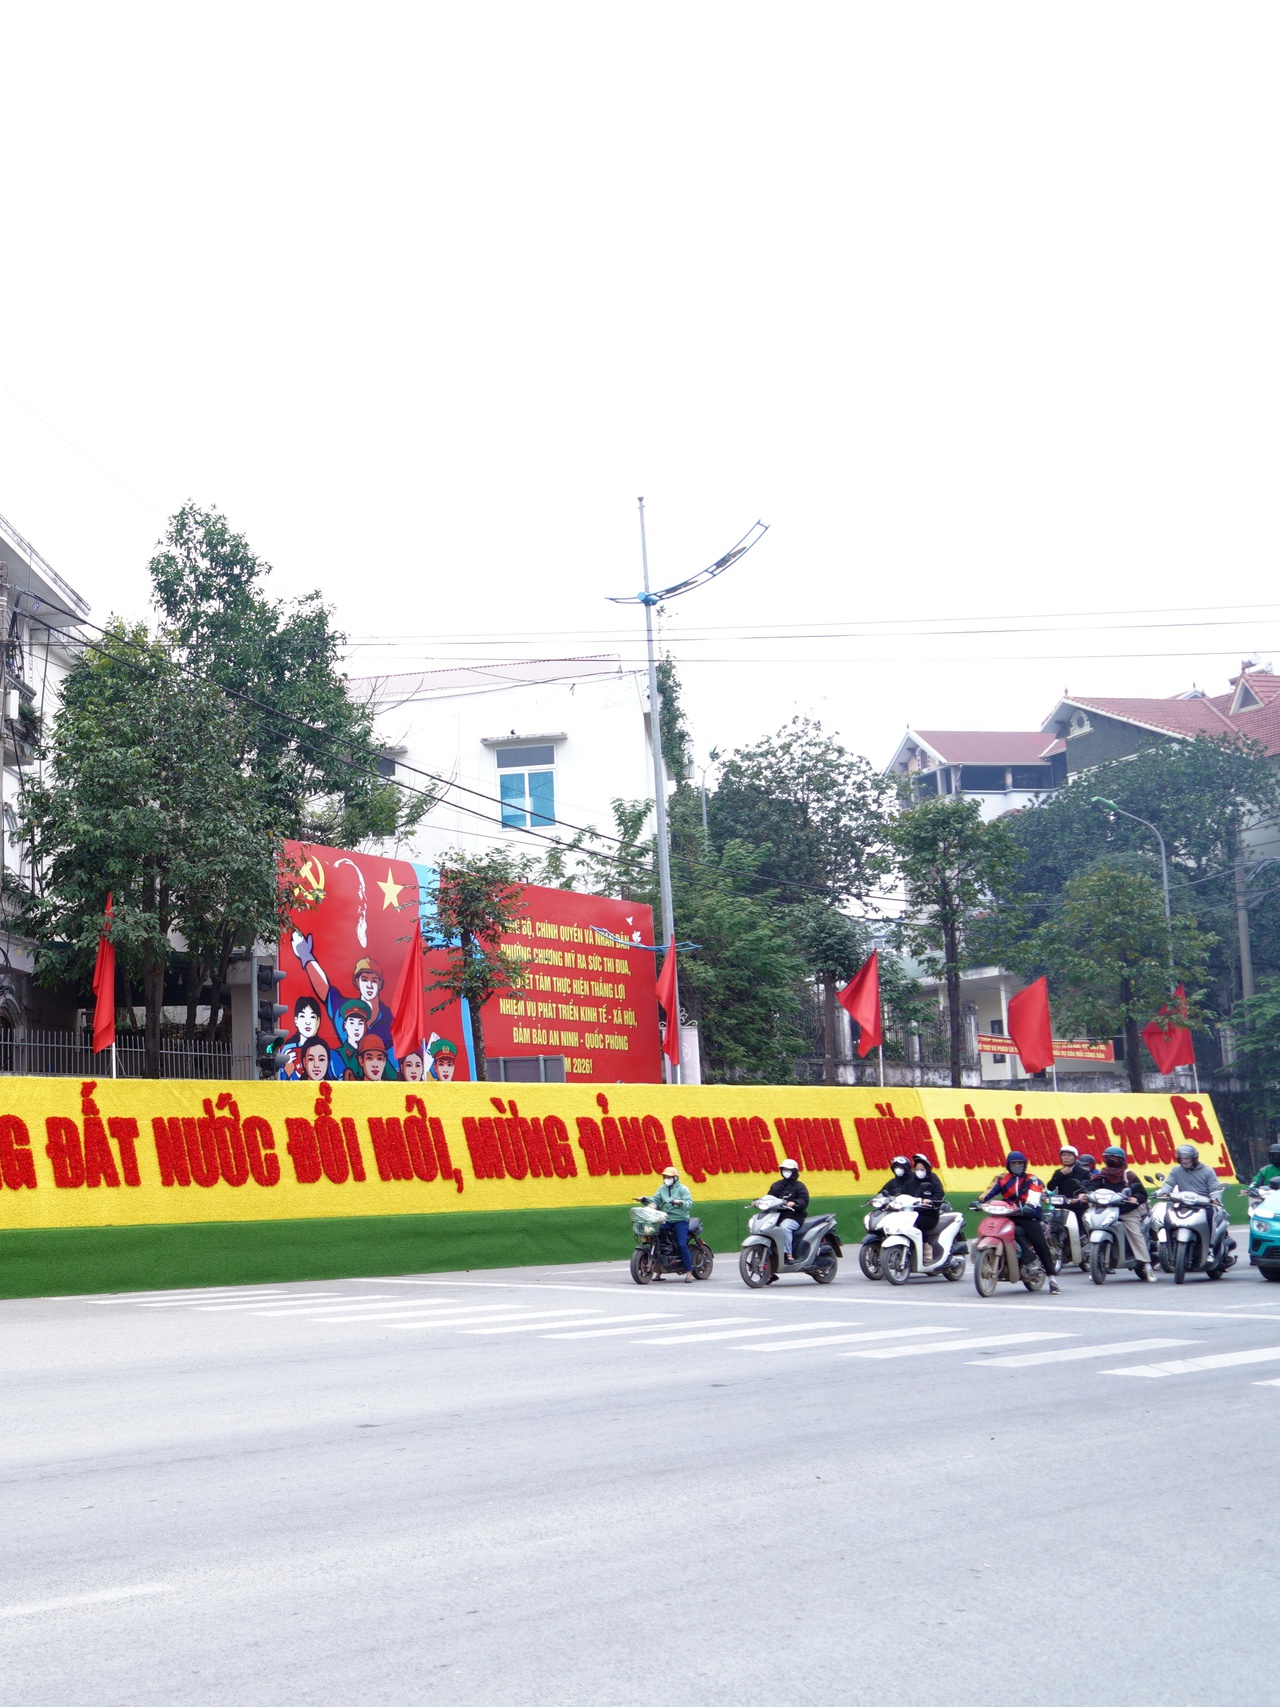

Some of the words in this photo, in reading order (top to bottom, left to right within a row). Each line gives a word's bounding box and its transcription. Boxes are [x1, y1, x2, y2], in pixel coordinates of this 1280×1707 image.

[536, 920, 558, 939] CHÍNH
[560, 923, 583, 943] QUYỀN
[585, 927, 593, 945] VÀ
[533, 947, 563, 966] CHƯƠNG
[565, 950, 576, 968] MỸ
[578, 954, 587, 970] RA
[588, 953, 602, 971] SỨC
[604, 957, 614, 973] THI
[616, 958, 631, 976] ĐUA,
[535, 972, 551, 991] TÂM
[552, 976, 571, 996] THỰC
[573, 977, 589, 998] HIỆN
[590, 976, 613, 998] THẮNG
[615, 983, 625, 1002] LỢI
[500, 998, 525, 1019] NHIỆM
[526, 1001, 536, 1020] VỤ
[538, 1000, 556, 1019] PHÁT
[558, 999, 579, 1021] TRIỂN
[580, 1006, 597, 1022] KINH
[599, 1004, 607, 1023] TẾ
[613, 1007, 622, 1024] XÃ
[624, 1008, 637, 1028] HỘI,
[513, 1022, 531, 1044] ĐẢM
[532, 1024, 547, 1045] BẢO
[549, 1030, 559, 1046] AN
[561, 1031, 579, 1047] NINH
[585, 1028, 604, 1049] QUỐC
[605, 1032, 629, 1050] PHÒNG
[573, 1058, 593, 1074] 2026!
[45, 1080, 141, 1188] ĐẤT
[152, 1092, 280, 1187] NƯỚC
[285, 1081, 366, 1184] ĐỔI
[368, 1094, 464, 1193] MỚI,
[462, 1097, 578, 1180] MỪNG
[576, 1092, 674, 1176] ĐẢNG
[672, 1115, 780, 1183] QUANG
[774, 1117, 860, 1180] VINH,
[854, 1102, 940, 1170] MỪNG
[1111, 1116, 1178, 1165] 2026!
